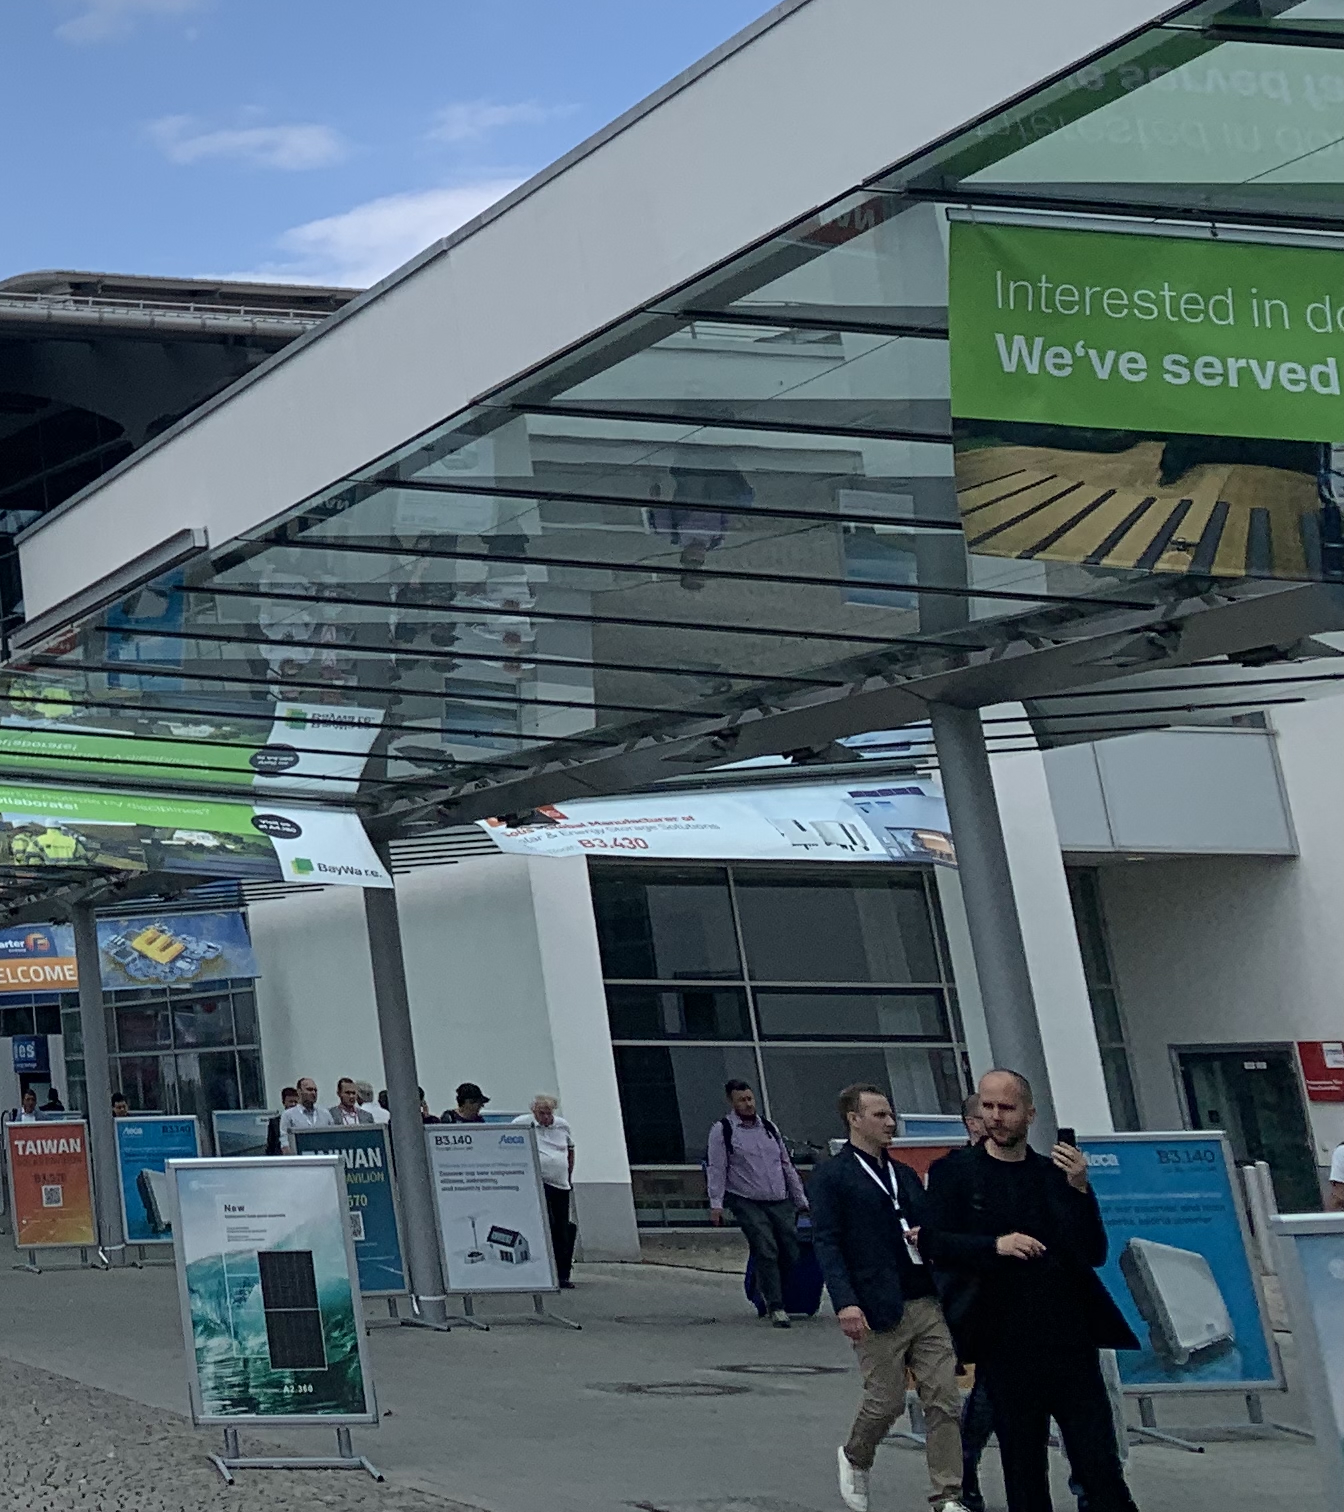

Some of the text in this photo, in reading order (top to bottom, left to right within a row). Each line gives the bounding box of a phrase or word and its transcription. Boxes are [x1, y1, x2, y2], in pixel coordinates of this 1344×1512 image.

[995, 269, 1235, 327] Interested
[1252, 288, 1290, 330] in
[995, 332, 1341, 396] We've served
[588, 816, 678, 827] Manufacturer
[577, 837, 649, 850] B3.430
[316, 862, 383, 878] BayWa r.e.
[14, 1138, 82, 1155] TAIWAN
[435, 1135, 472, 1146] B3.140
[1156, 1150, 1216, 1164] B3.140
[344, 1171, 385, 1184] AVILION
[223, 1204, 245, 1212] New
